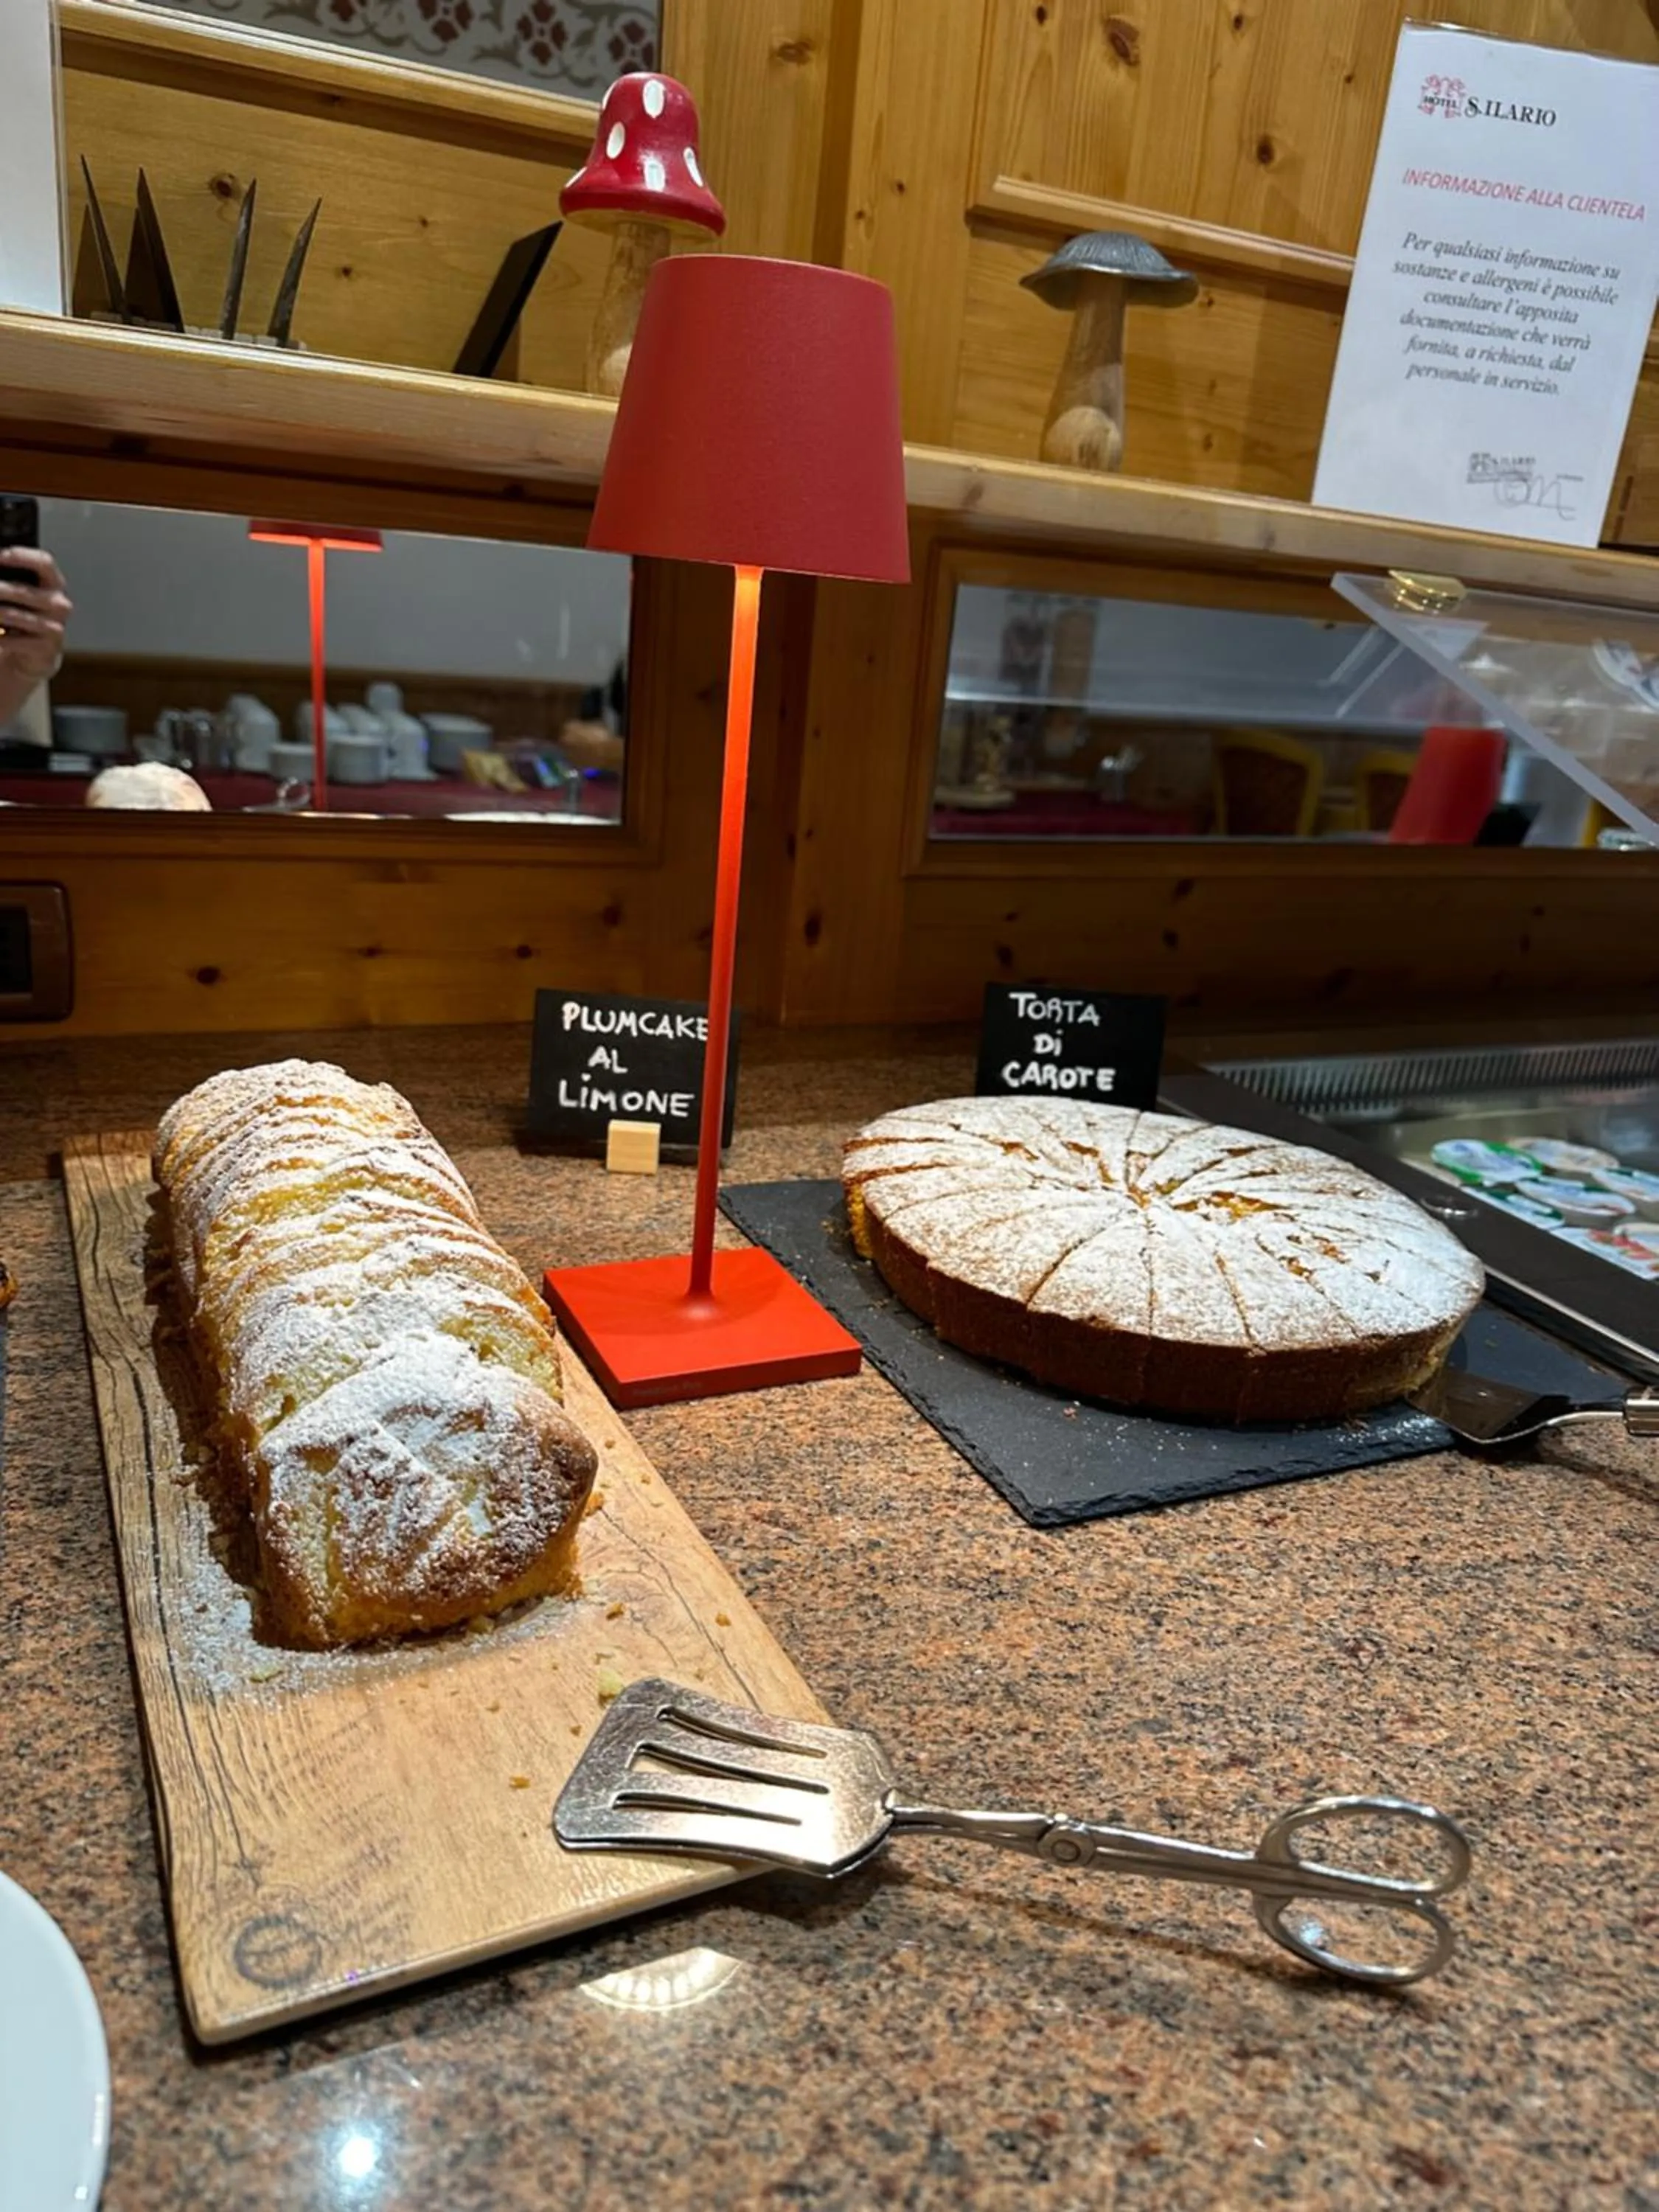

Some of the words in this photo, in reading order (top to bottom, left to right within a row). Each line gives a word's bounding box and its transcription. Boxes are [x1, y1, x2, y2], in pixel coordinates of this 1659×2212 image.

[1422, 95, 1458, 108] HOTEL
[1464, 96, 1557, 127] S.ILARIO
[1402, 167, 1526, 202] INFORMAZIONE
[1525, 188, 1564, 209] ALLA
[1566, 194, 1646, 222] CLIENTELA
[1402, 232, 1432, 251] Per
[1433, 239, 1503, 263] qualsiasi
[1504, 248, 1601, 278] informazione
[1602, 265, 1620, 280] su
[1392, 260, 1458, 282] sostanze
[1459, 271, 1471, 283] e
[1472, 271, 1540, 293] allergeni
[1540, 276, 1552, 293] è
[1550, 281, 1619, 305] possibile
[1423, 290, 1503, 312] consultare
[1399, 310, 1520, 340] documentazione
[1521, 325, 1548, 344] che
[1551, 333, 1591, 351] verrà
[1402, 335, 1460, 358] fornita,
[1464, 347, 1476, 359] a
[1478, 348, 1546, 370] richiesta,
[1548, 355, 1576, 372] dal
[1405, 362, 1481, 386] personale
[1482, 372, 1500, 388] in
[1500, 377, 1560, 397] servizio.
[561, 1001, 709, 1041] PLUMCAKE
[1009, 991, 1101, 1026] TORTA
[588, 1046, 628, 1074] AL
[1001, 1060, 1116, 1092] CAROTE
